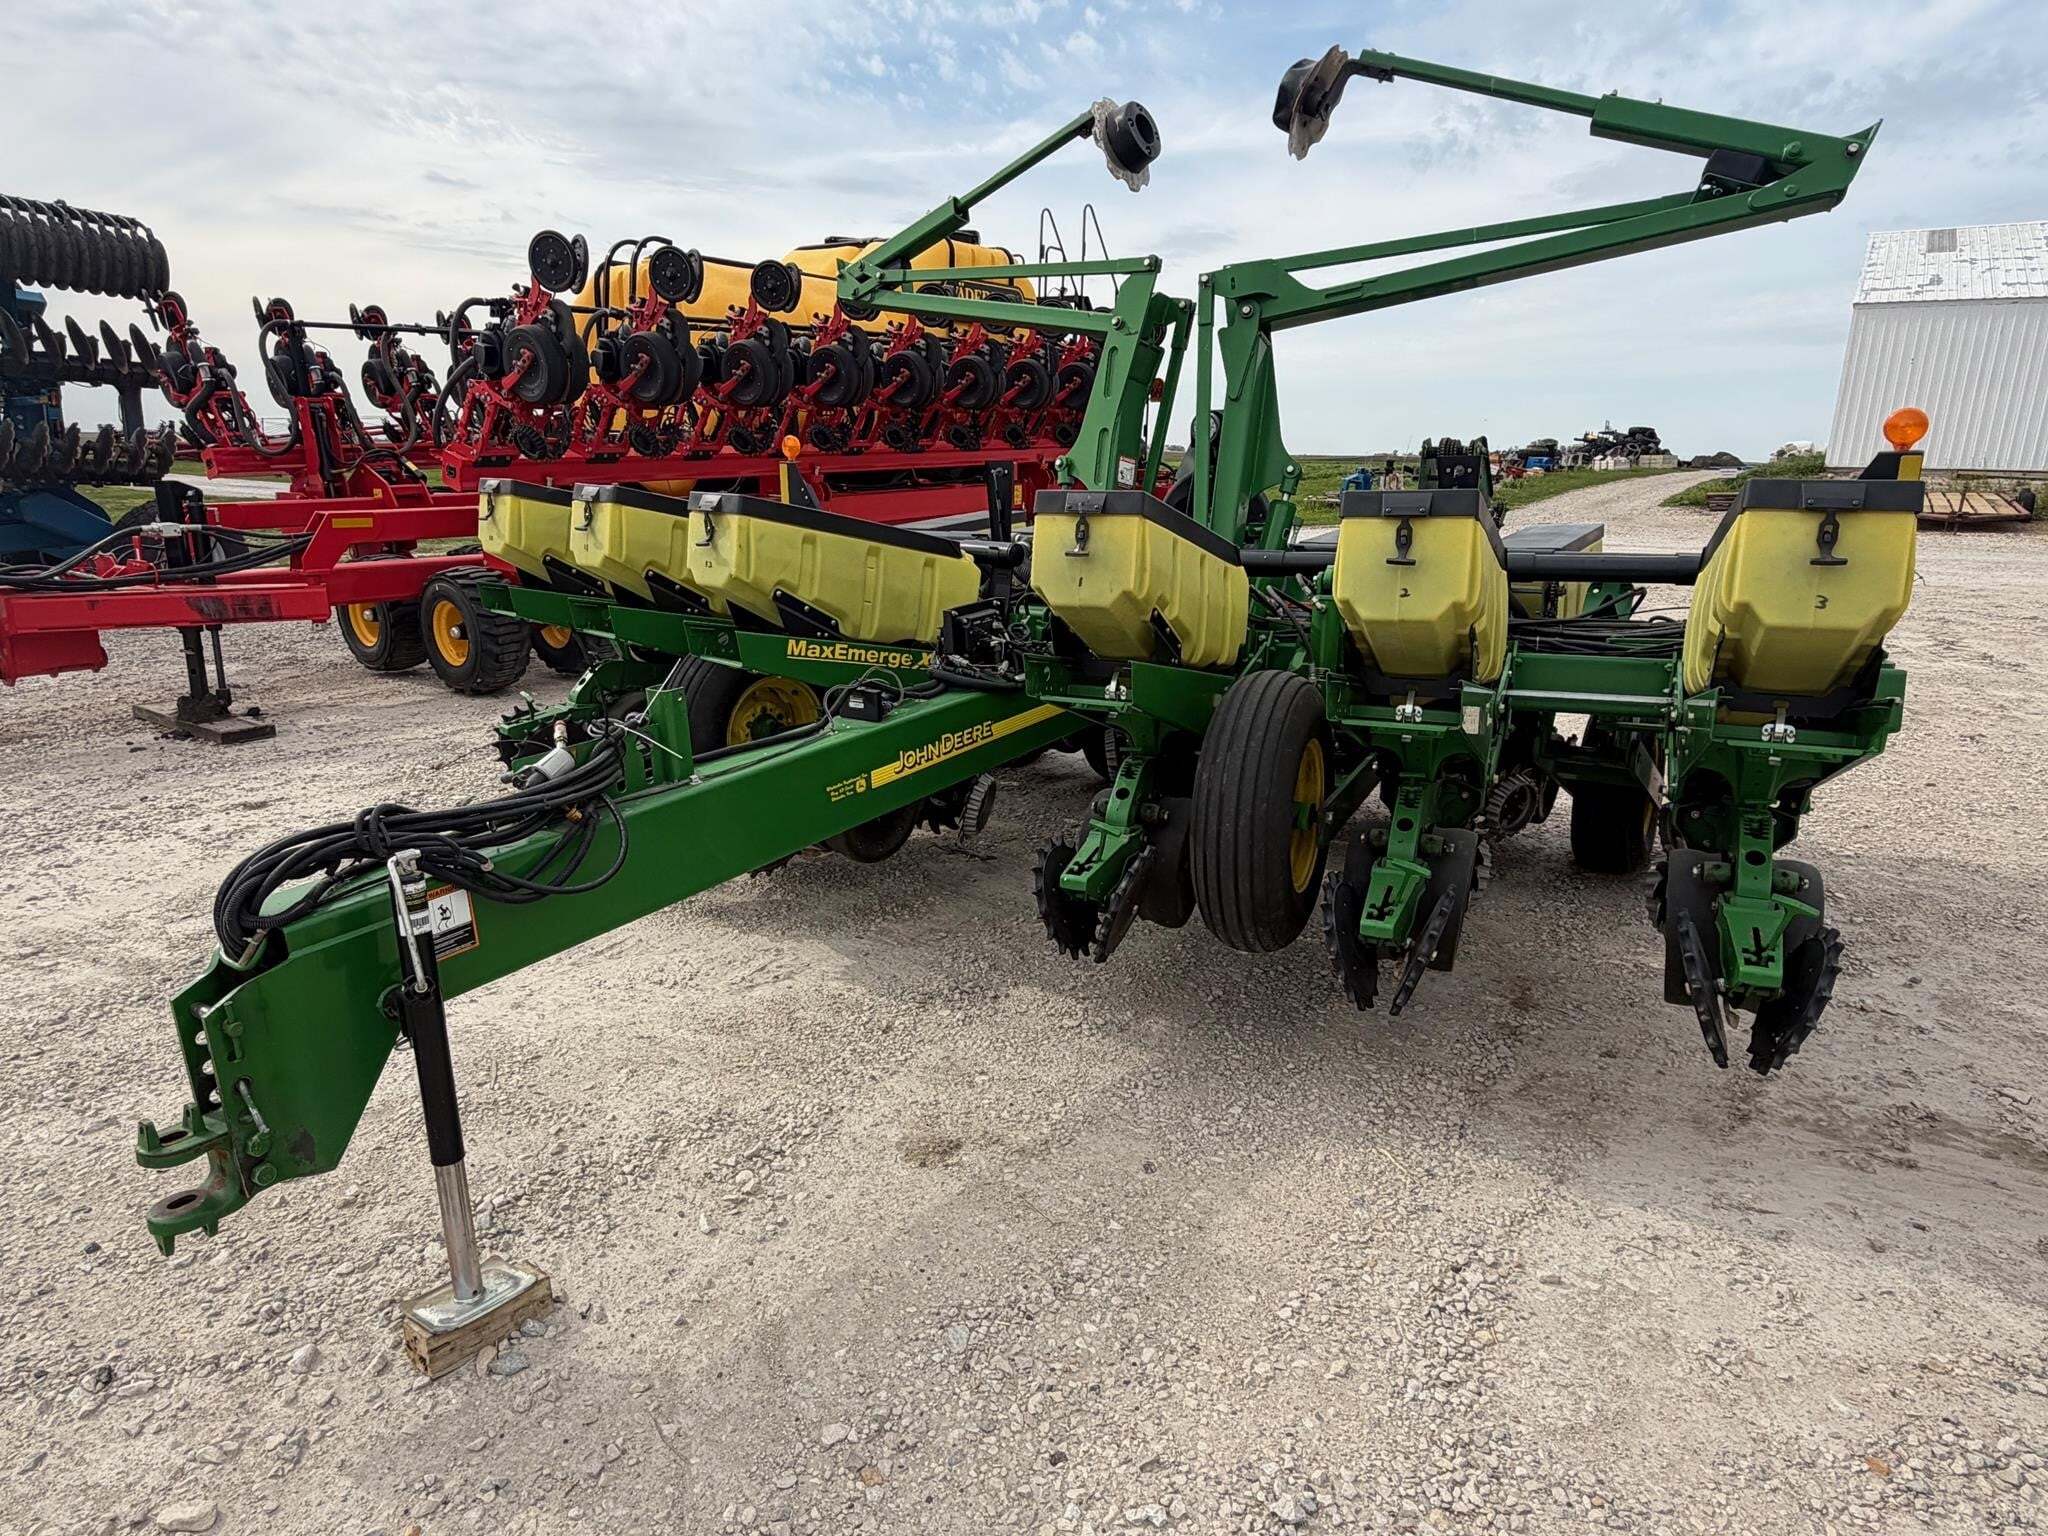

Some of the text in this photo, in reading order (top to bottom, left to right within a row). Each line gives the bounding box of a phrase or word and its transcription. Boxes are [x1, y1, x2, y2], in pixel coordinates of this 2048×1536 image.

[1399, 587, 1411, 598] 2
[1813, 594, 1829, 610] 3
[786, 639, 913, 668] MaxEmerge
[894, 720, 993, 774] JOHN DEERE
